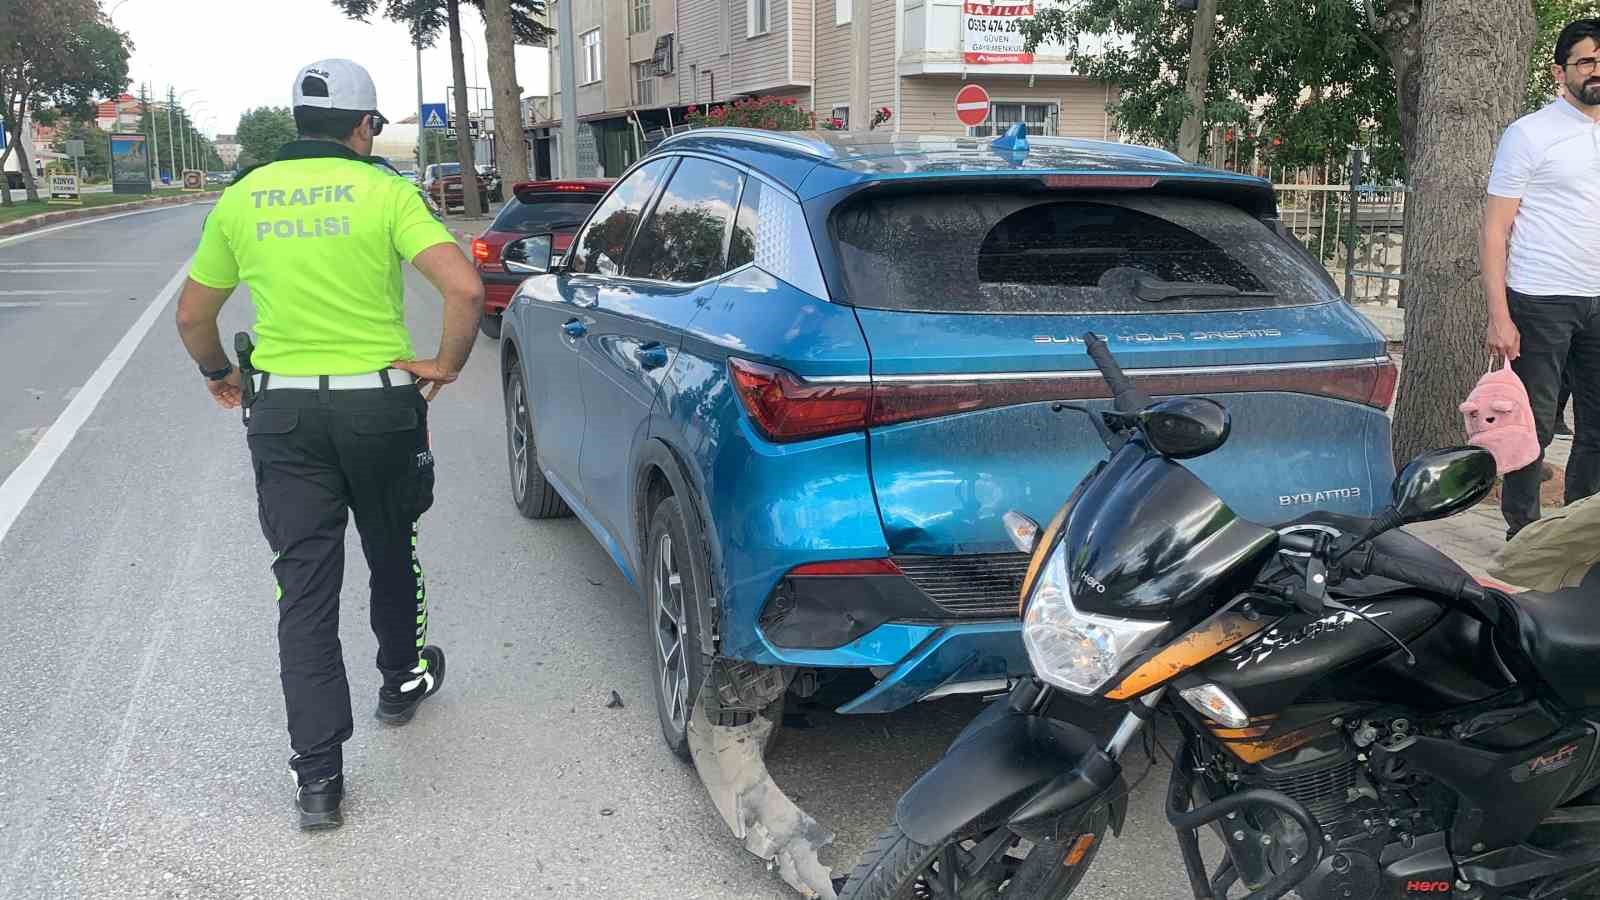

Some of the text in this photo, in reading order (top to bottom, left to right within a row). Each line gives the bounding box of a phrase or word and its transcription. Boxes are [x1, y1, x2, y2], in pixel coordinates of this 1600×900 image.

[988, 20, 1003, 32] 474
[1119, 333, 1185, 343] YOUR
[1279, 493, 1312, 506] BYD
[1081, 570, 1106, 593] Hero
[1407, 880, 1450, 892] Hero
